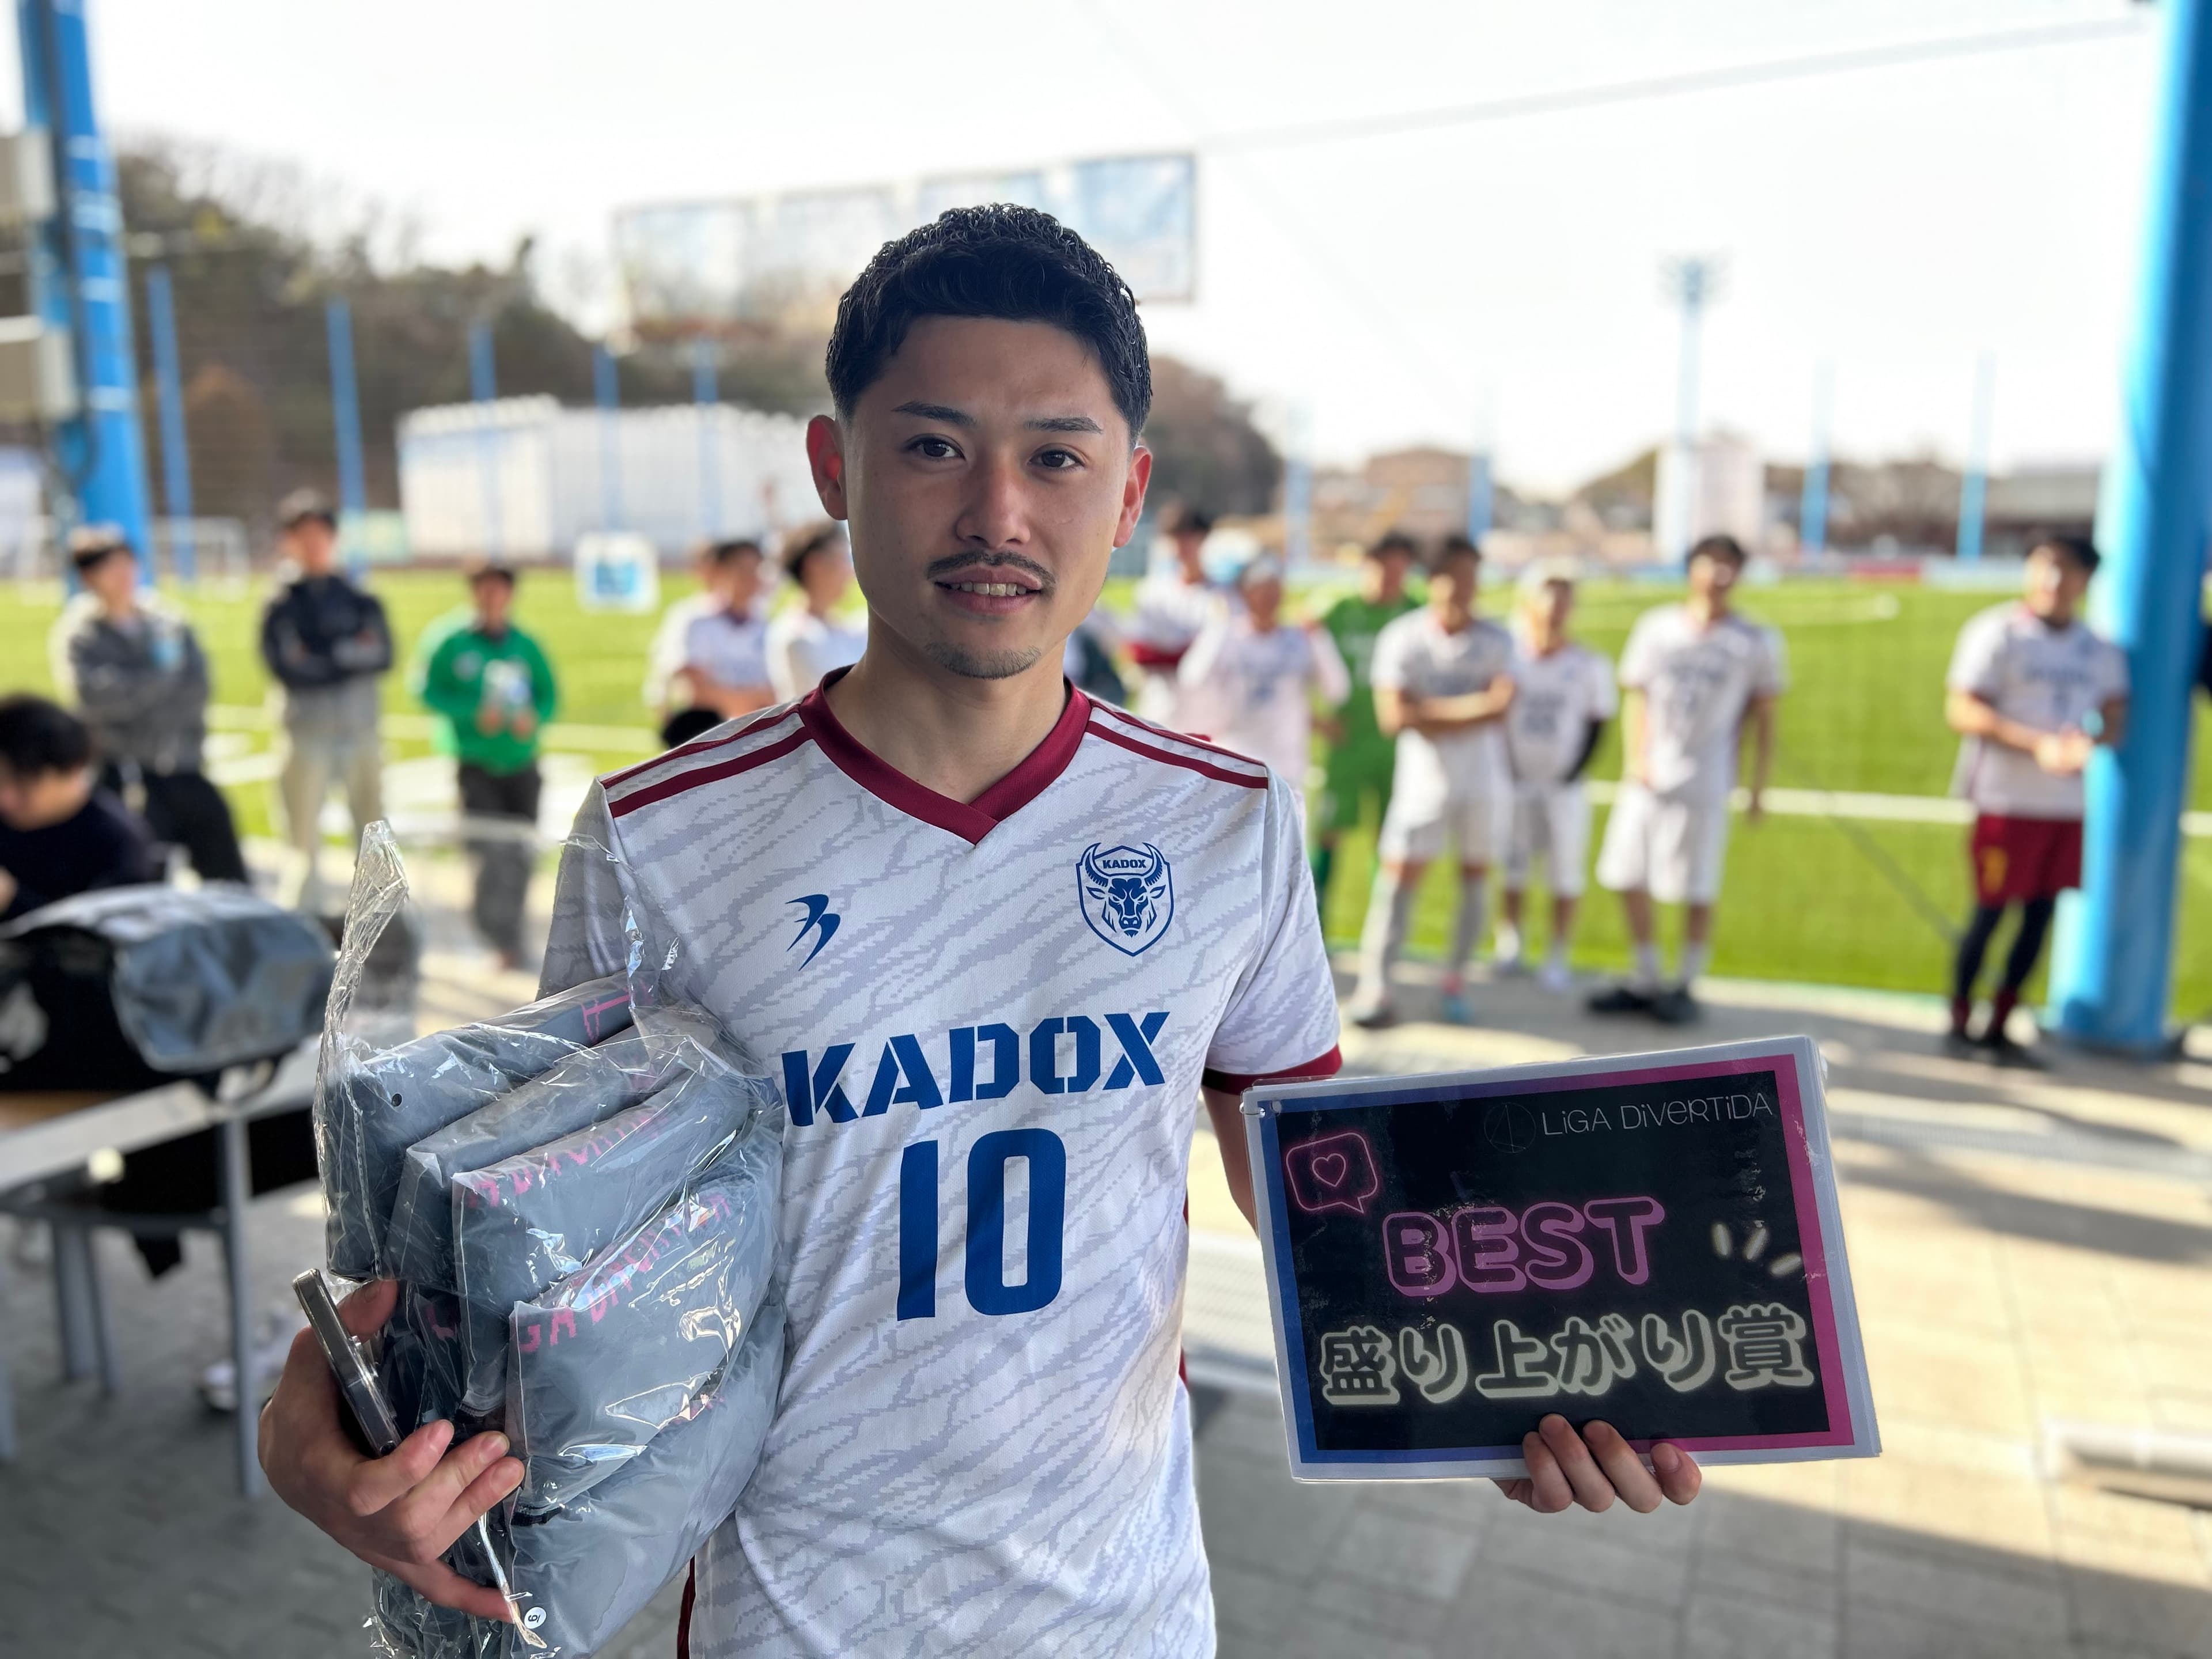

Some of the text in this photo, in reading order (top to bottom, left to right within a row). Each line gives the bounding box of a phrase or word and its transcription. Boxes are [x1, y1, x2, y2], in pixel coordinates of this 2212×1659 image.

[1102, 859, 1147, 869] KADOX
[781, 1011, 1171, 1127] KADOX
[897, 1127, 1067, 1321] 10
[1382, 1195, 1665, 1297] BEST
[1319, 1302, 1815, 1406] 盛り上がり賞
